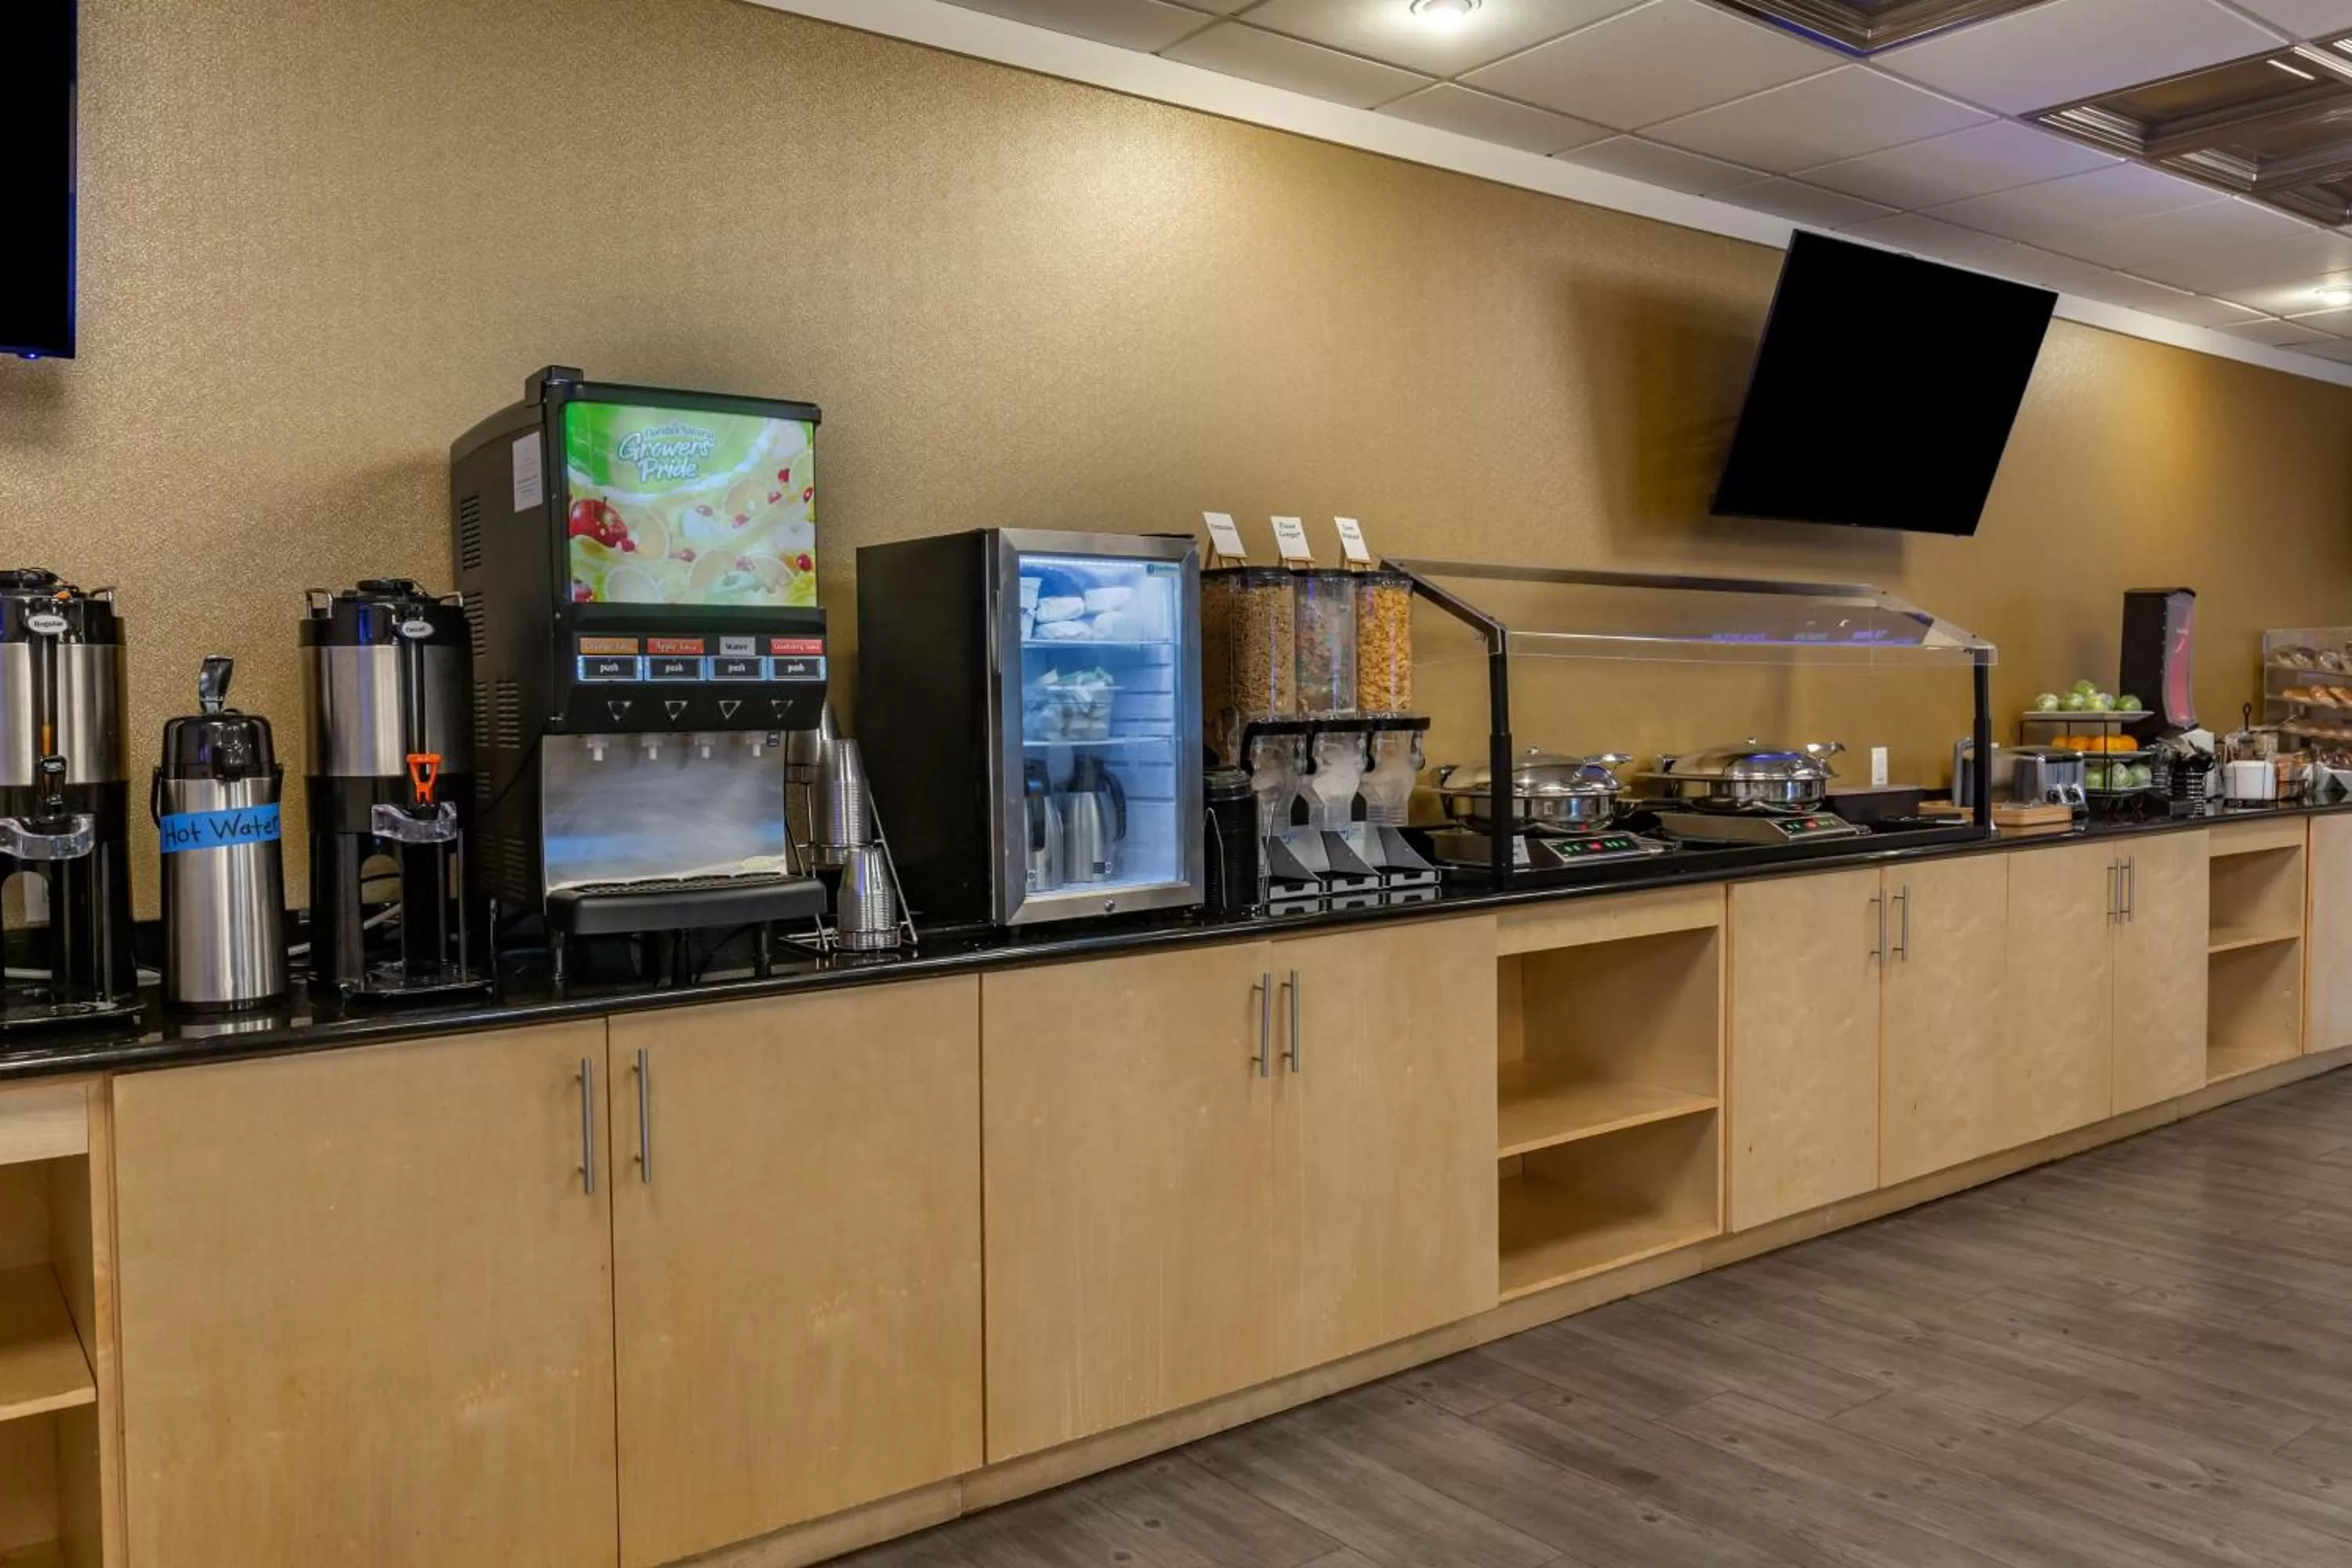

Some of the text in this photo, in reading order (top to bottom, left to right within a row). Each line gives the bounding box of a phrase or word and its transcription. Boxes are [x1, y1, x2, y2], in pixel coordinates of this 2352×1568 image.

[637, 456, 699, 483] Pride
[724, 641, 748, 651] Water
[599, 662, 620, 674] push
[664, 662, 684, 674] push
[727, 662, 746, 674] push
[787, 662, 806, 674] push
[164, 812, 279, 847] Hot Water
